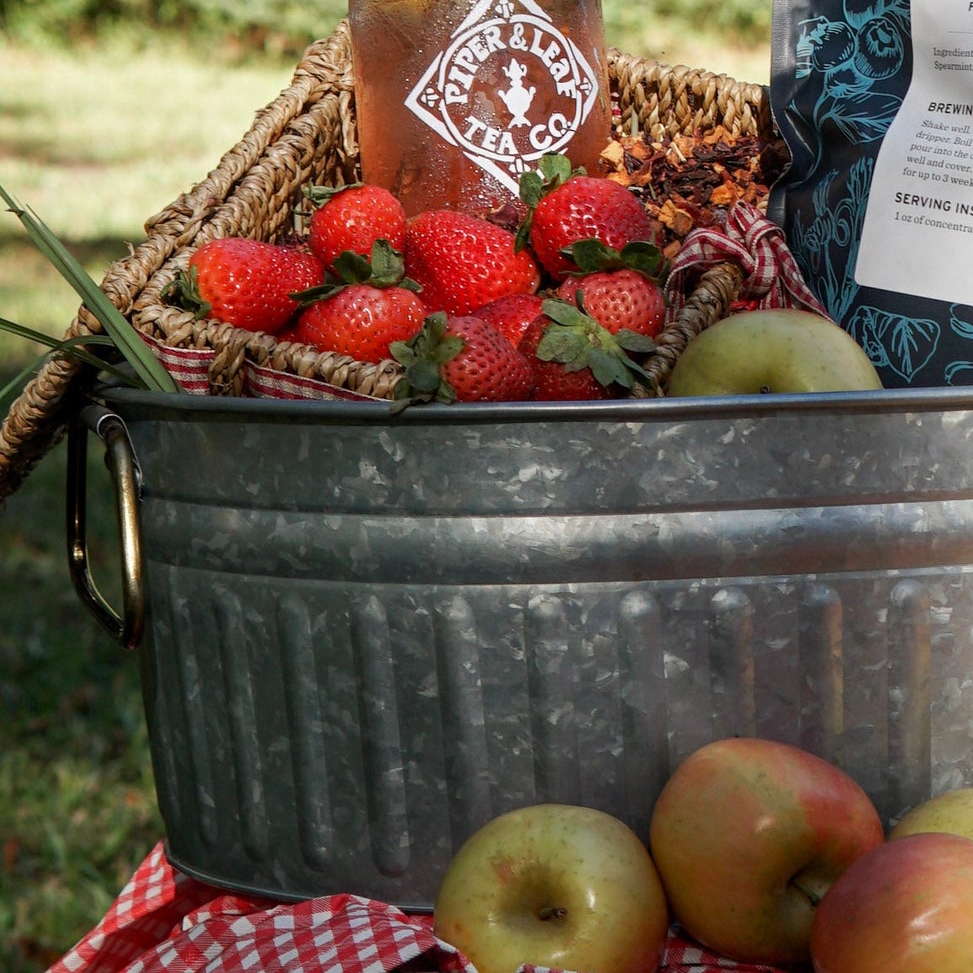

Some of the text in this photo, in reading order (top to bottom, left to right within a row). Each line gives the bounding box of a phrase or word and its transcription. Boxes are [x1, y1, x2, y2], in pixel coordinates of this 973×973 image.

[445, 27, 507, 105] PIPER
[509, 23, 529, 51] &
[921, 120, 950, 132] Shake
[464, 115, 519, 155] TEA
[953, 137, 972, 147] Boil
[910, 143, 933, 153] pour
[933, 143, 953, 155] into
[953, 148, 969, 158] the
[906, 155, 925, 165] well
[926, 158, 944, 168] and
[945, 162, 973, 174] cover.
[902, 167, 918, 177] for
[918, 171, 930, 181] up
[931, 171, 941, 181] to
[942, 174, 949, 183] 3
[895, 192, 952, 212] SERVING
[894, 211, 900, 221] 1
[901, 213, 912, 222] oz
[914, 215, 925, 225] of
